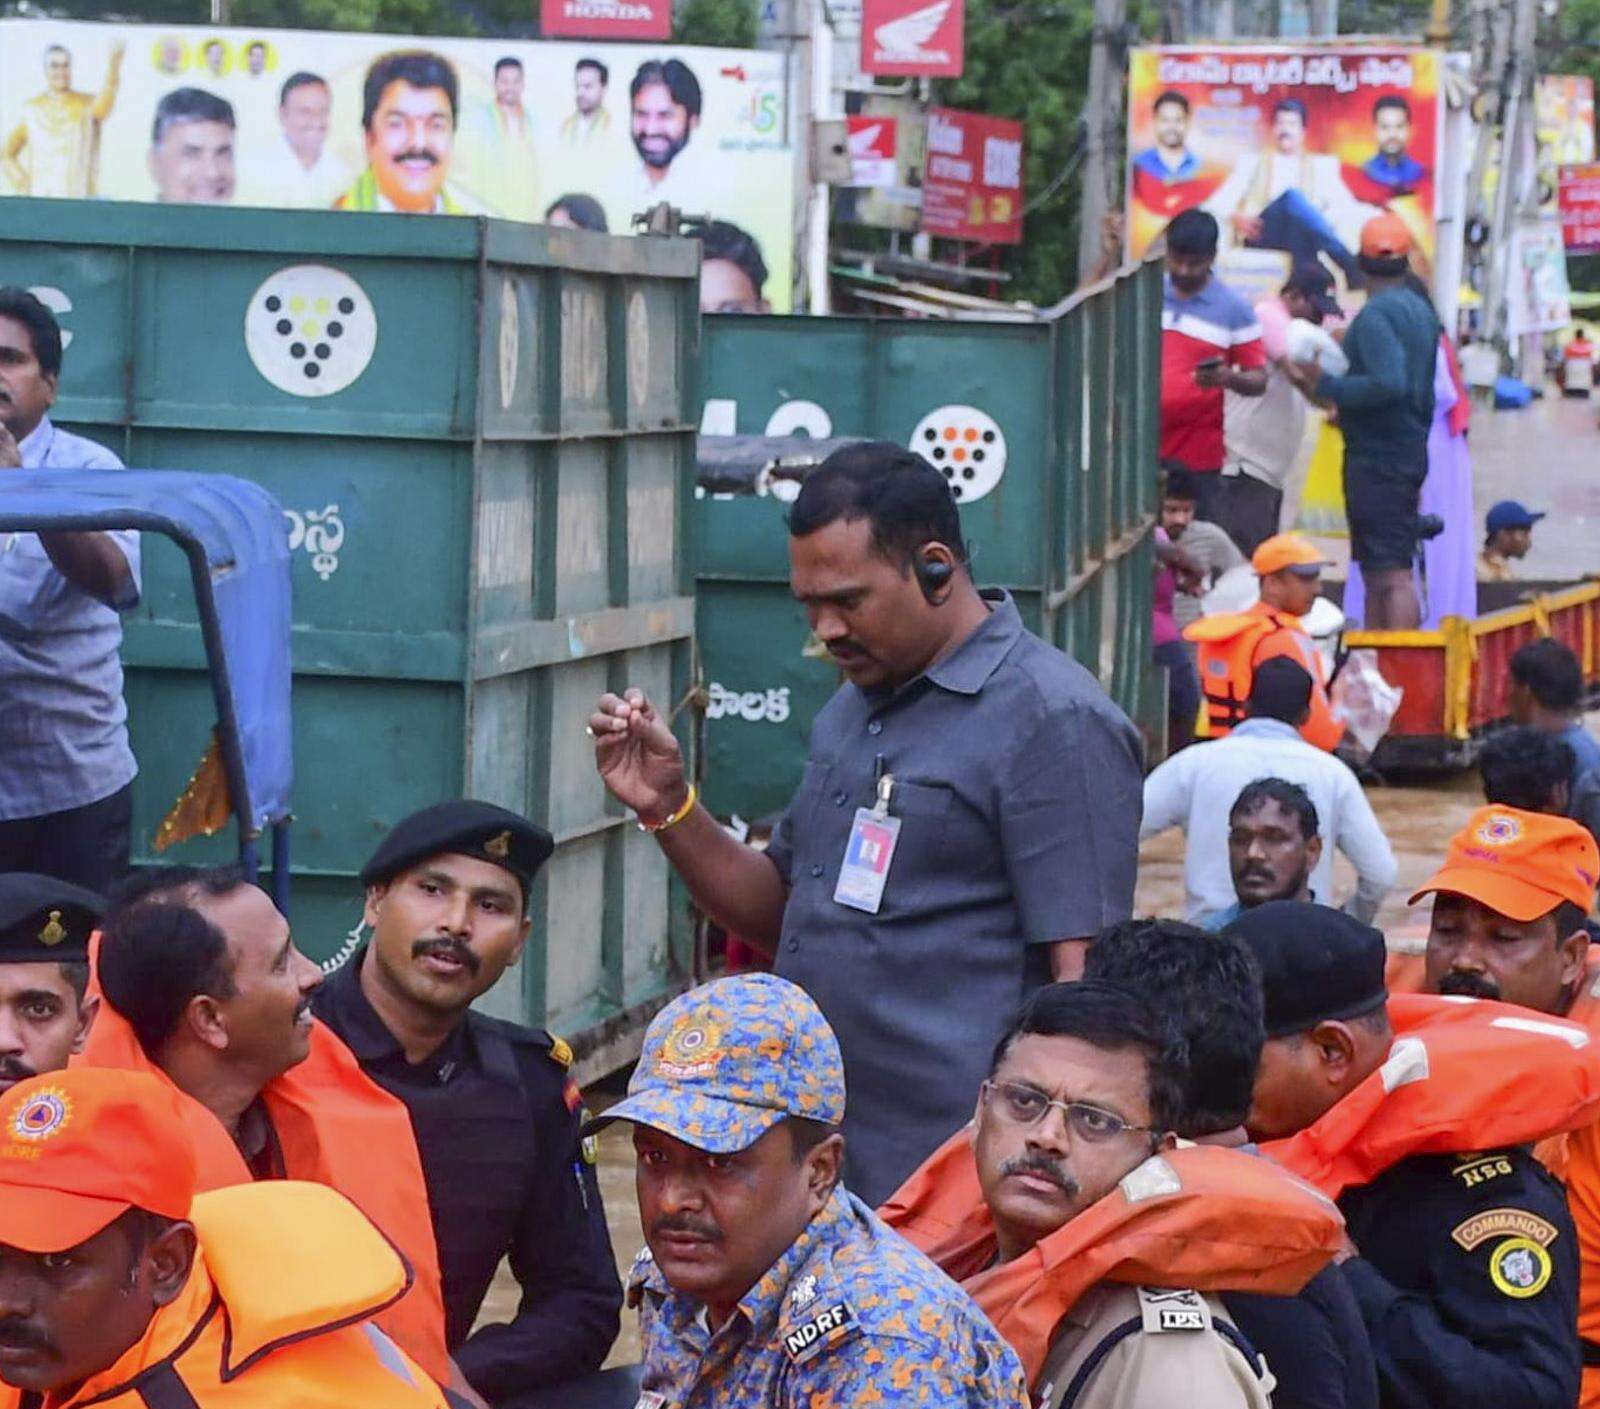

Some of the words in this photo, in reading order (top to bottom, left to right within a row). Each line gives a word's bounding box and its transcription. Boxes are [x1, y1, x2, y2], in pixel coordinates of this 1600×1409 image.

[1461, 1159, 1513, 1188] NSG
[1461, 1214, 1549, 1242] COMMANDO
[786, 1304, 844, 1354] NDRF
